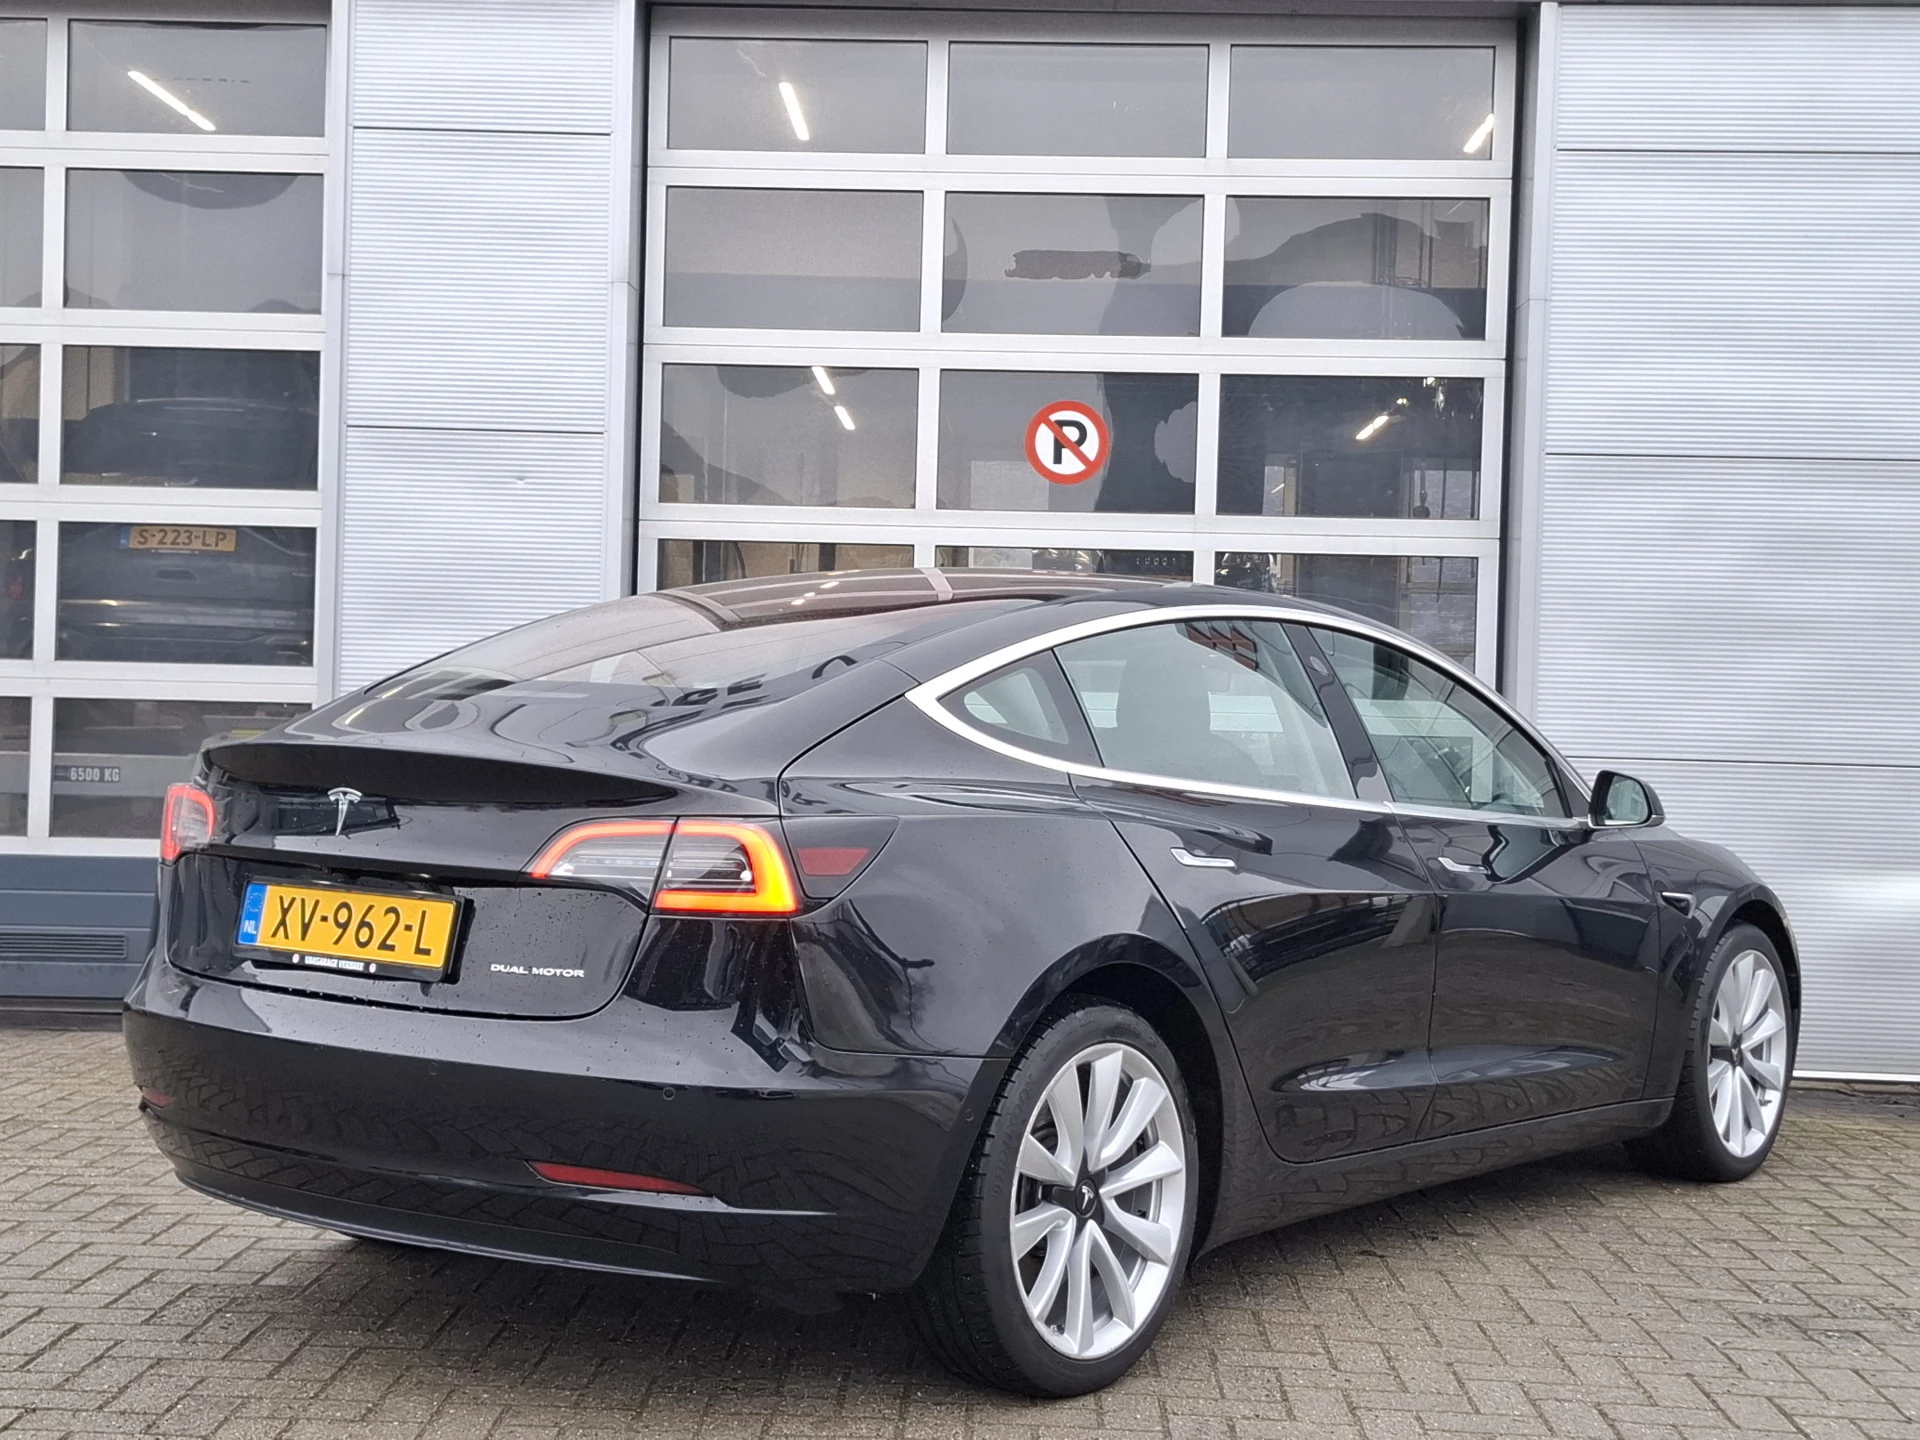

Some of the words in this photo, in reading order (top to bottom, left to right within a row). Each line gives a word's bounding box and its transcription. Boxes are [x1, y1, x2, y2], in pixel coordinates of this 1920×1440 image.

[1053, 419, 1087, 465] P
[137, 528, 227, 548] S-223-LP
[70, 767, 100, 781] 6500
[104, 768, 120, 782] KG
[243, 920, 257, 935] NL
[270, 895, 432, 957] XV-962-L
[490, 963, 529, 975] DUAL
[532, 967, 585, 978] MOTOR
